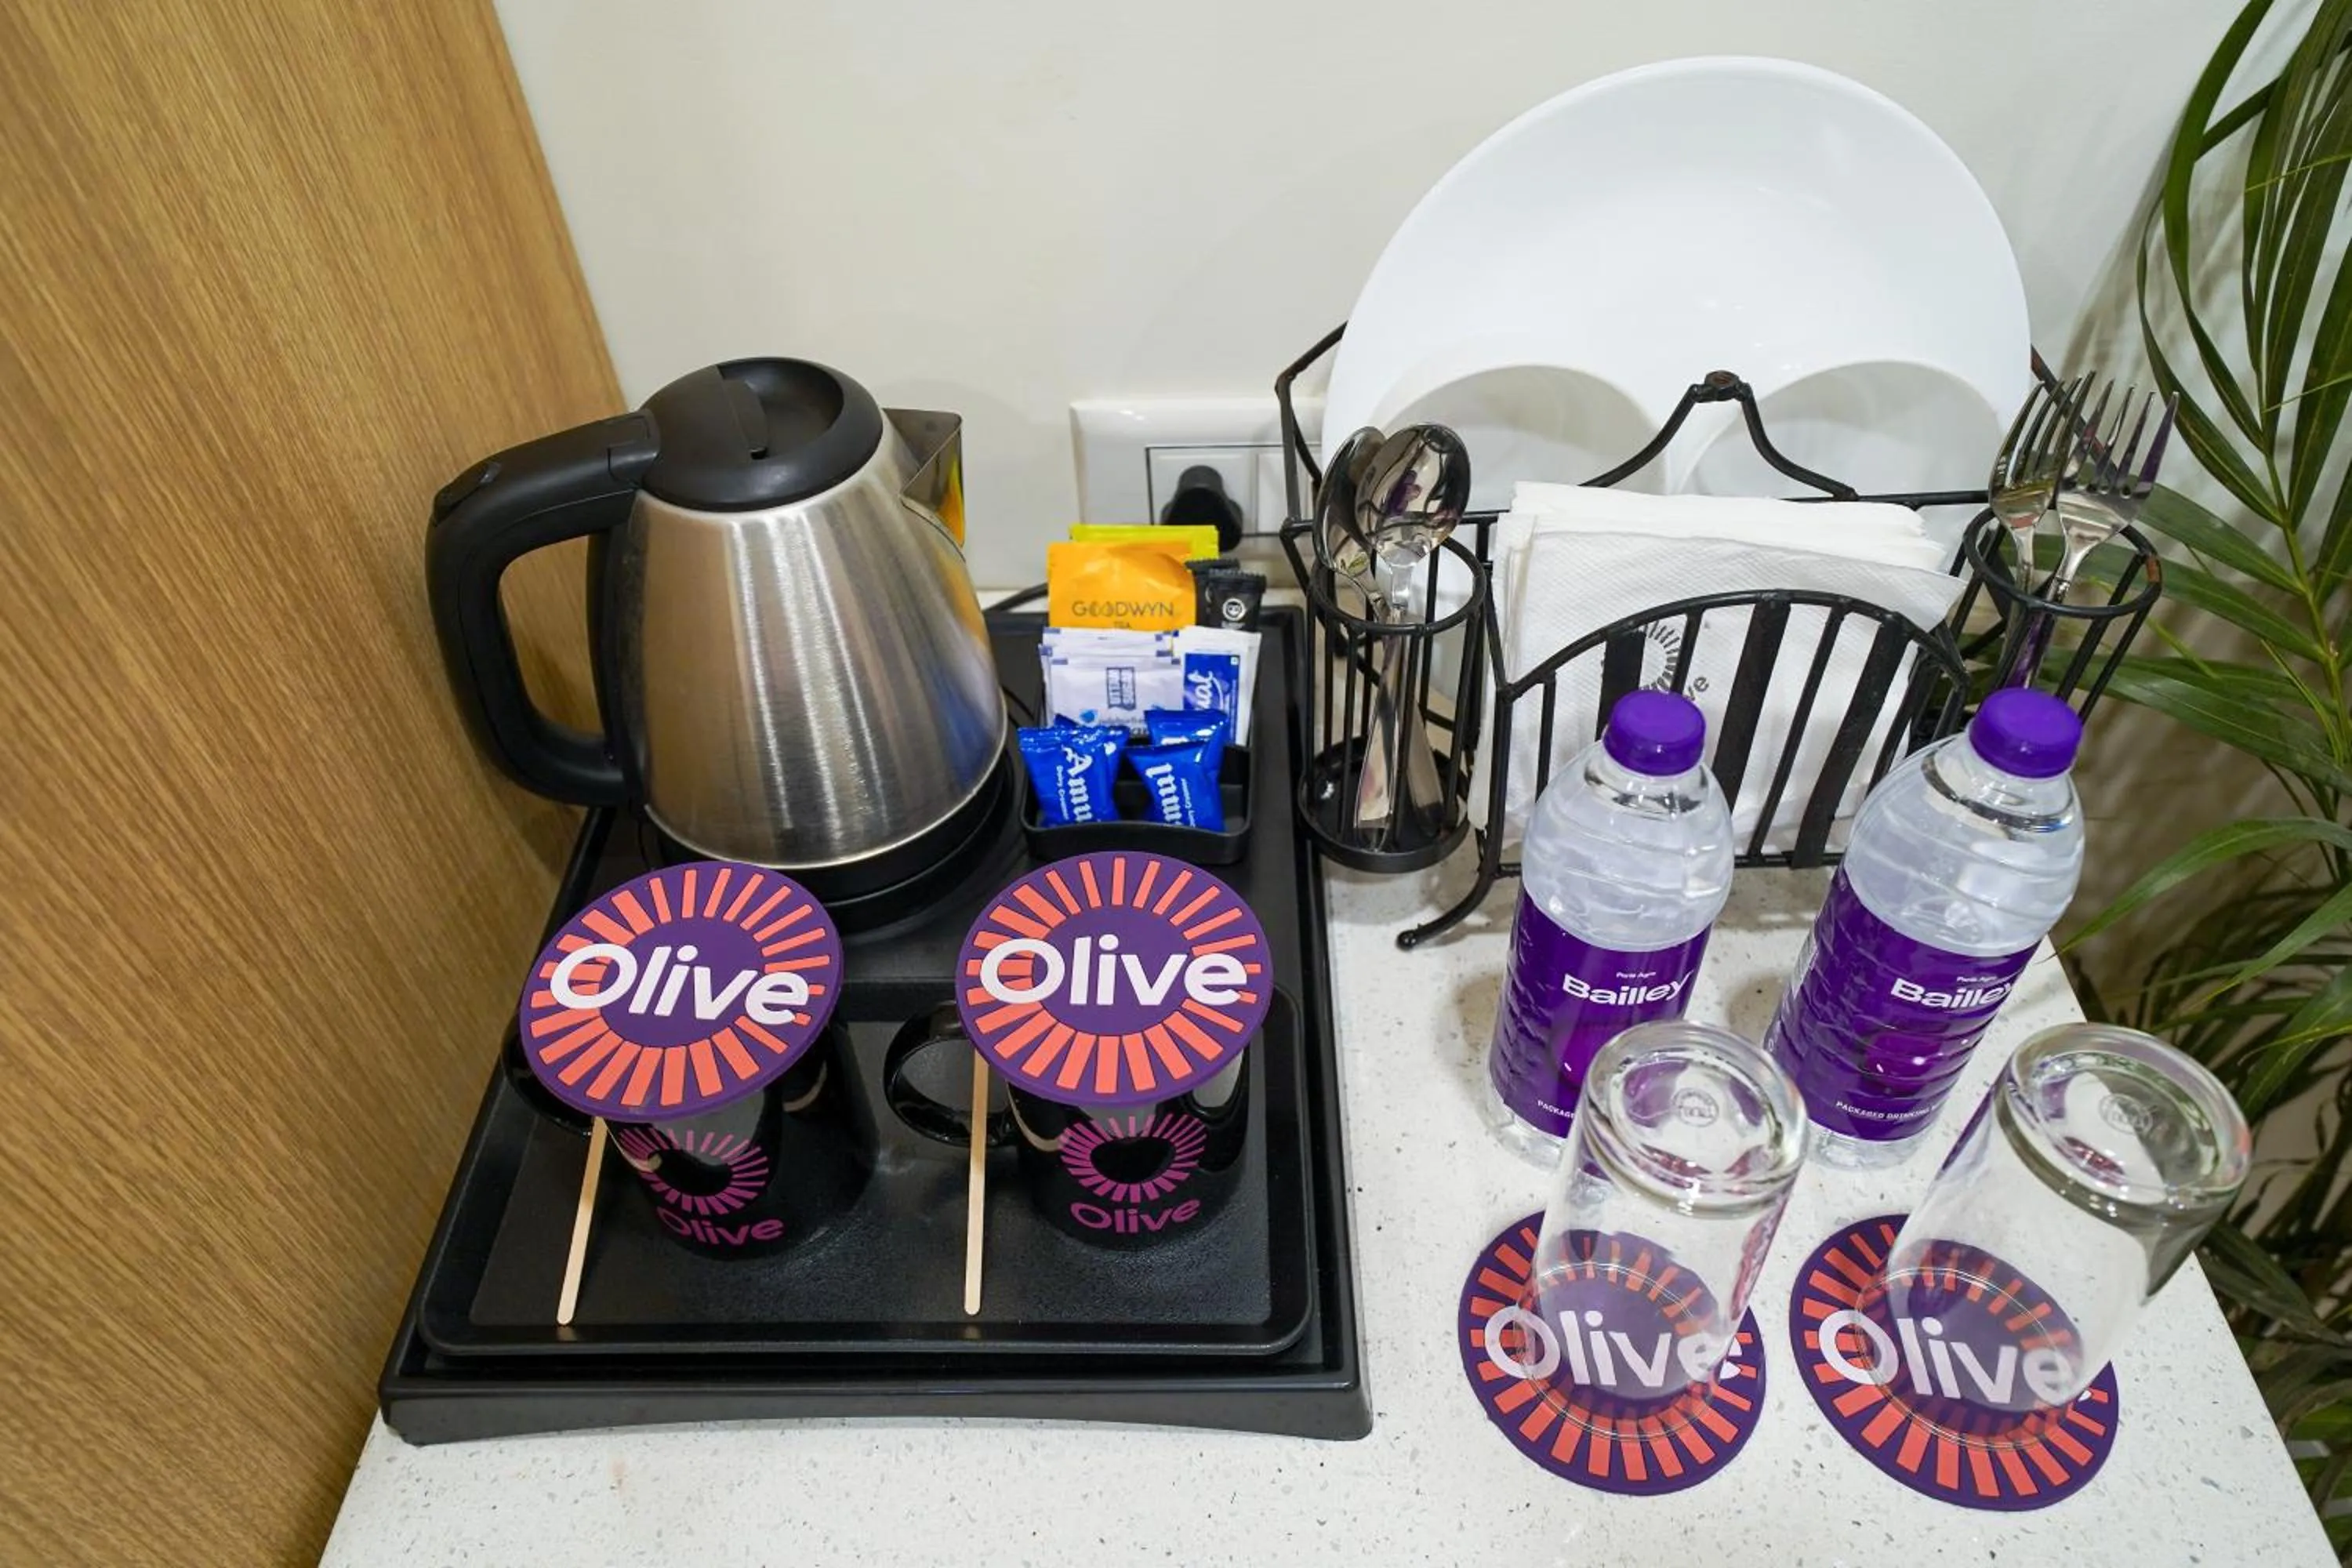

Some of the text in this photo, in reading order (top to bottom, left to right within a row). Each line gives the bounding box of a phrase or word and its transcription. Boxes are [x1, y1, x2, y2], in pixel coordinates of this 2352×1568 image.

[1071, 601, 1174, 617] GOODWYN
[1061, 744, 1093, 822] Amu
[1145, 762, 1182, 826] mul
[550, 942, 809, 1025] Olive
[980, 934, 1247, 1006] Olive
[1563, 970, 1693, 1006] Bailley
[1537, 1099, 1575, 1120] PACKAGE
[656, 1206, 784, 1245] Olive
[1069, 1199, 1201, 1233] Olive
[1484, 1305, 1742, 1388] Olive
[1818, 1309, 2091, 1407] Olive
